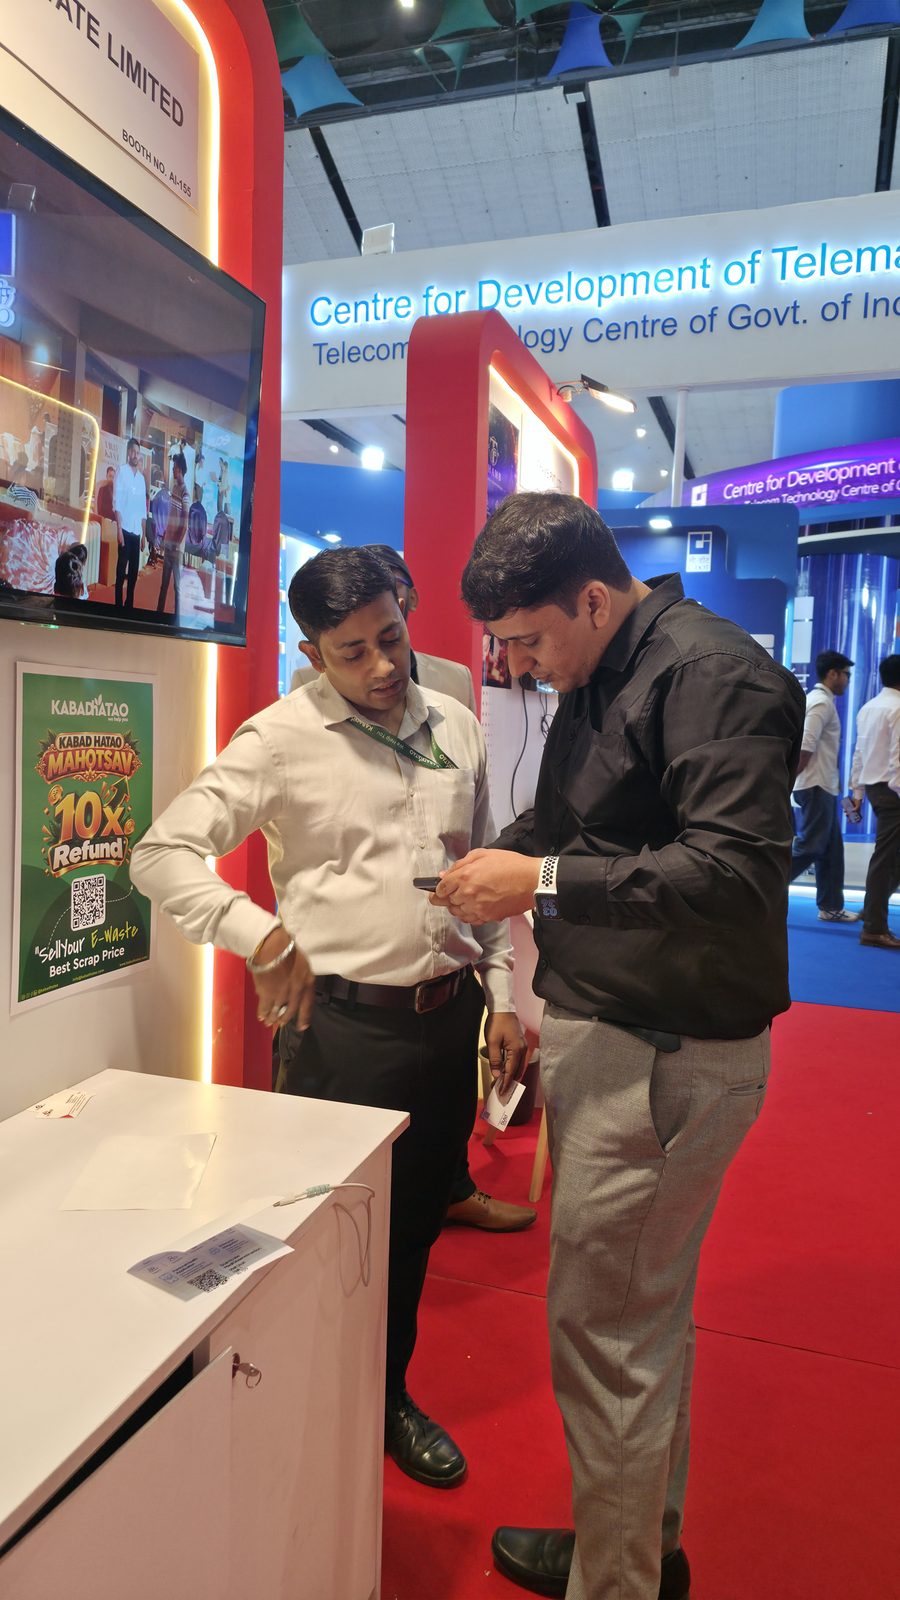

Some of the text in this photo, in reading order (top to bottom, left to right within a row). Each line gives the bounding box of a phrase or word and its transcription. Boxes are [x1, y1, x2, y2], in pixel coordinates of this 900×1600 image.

[48, 0, 184, 127] ATE LIMITED
[122, 129, 191, 198] BOOTH NO. AI-155
[310, 242, 900, 327] Centre for Development of Telem
[583, 314, 678, 343] Centre
[690, 306, 719, 335] of
[728, 300, 807, 331] Govt.
[821, 293, 853, 322] of
[723, 479, 764, 500] Centre
[766, 474, 786, 491] for
[787, 458, 896, 488] Development
[782, 488, 841, 504] Technology
[841, 481, 879, 497] Centre
[881, 479, 896, 493] of
[58, 736, 122, 748] KABAD HATAO
[47, 749, 133, 777] MAHOTSAV
[54, 790, 126, 844] 10x
[52, 838, 124, 870] Refund
[91, 921, 139, 948] E-Waste
[50, 961, 71, 977] Best
[73, 953, 100, 971] Scrap
[102, 946, 125, 962] Price
